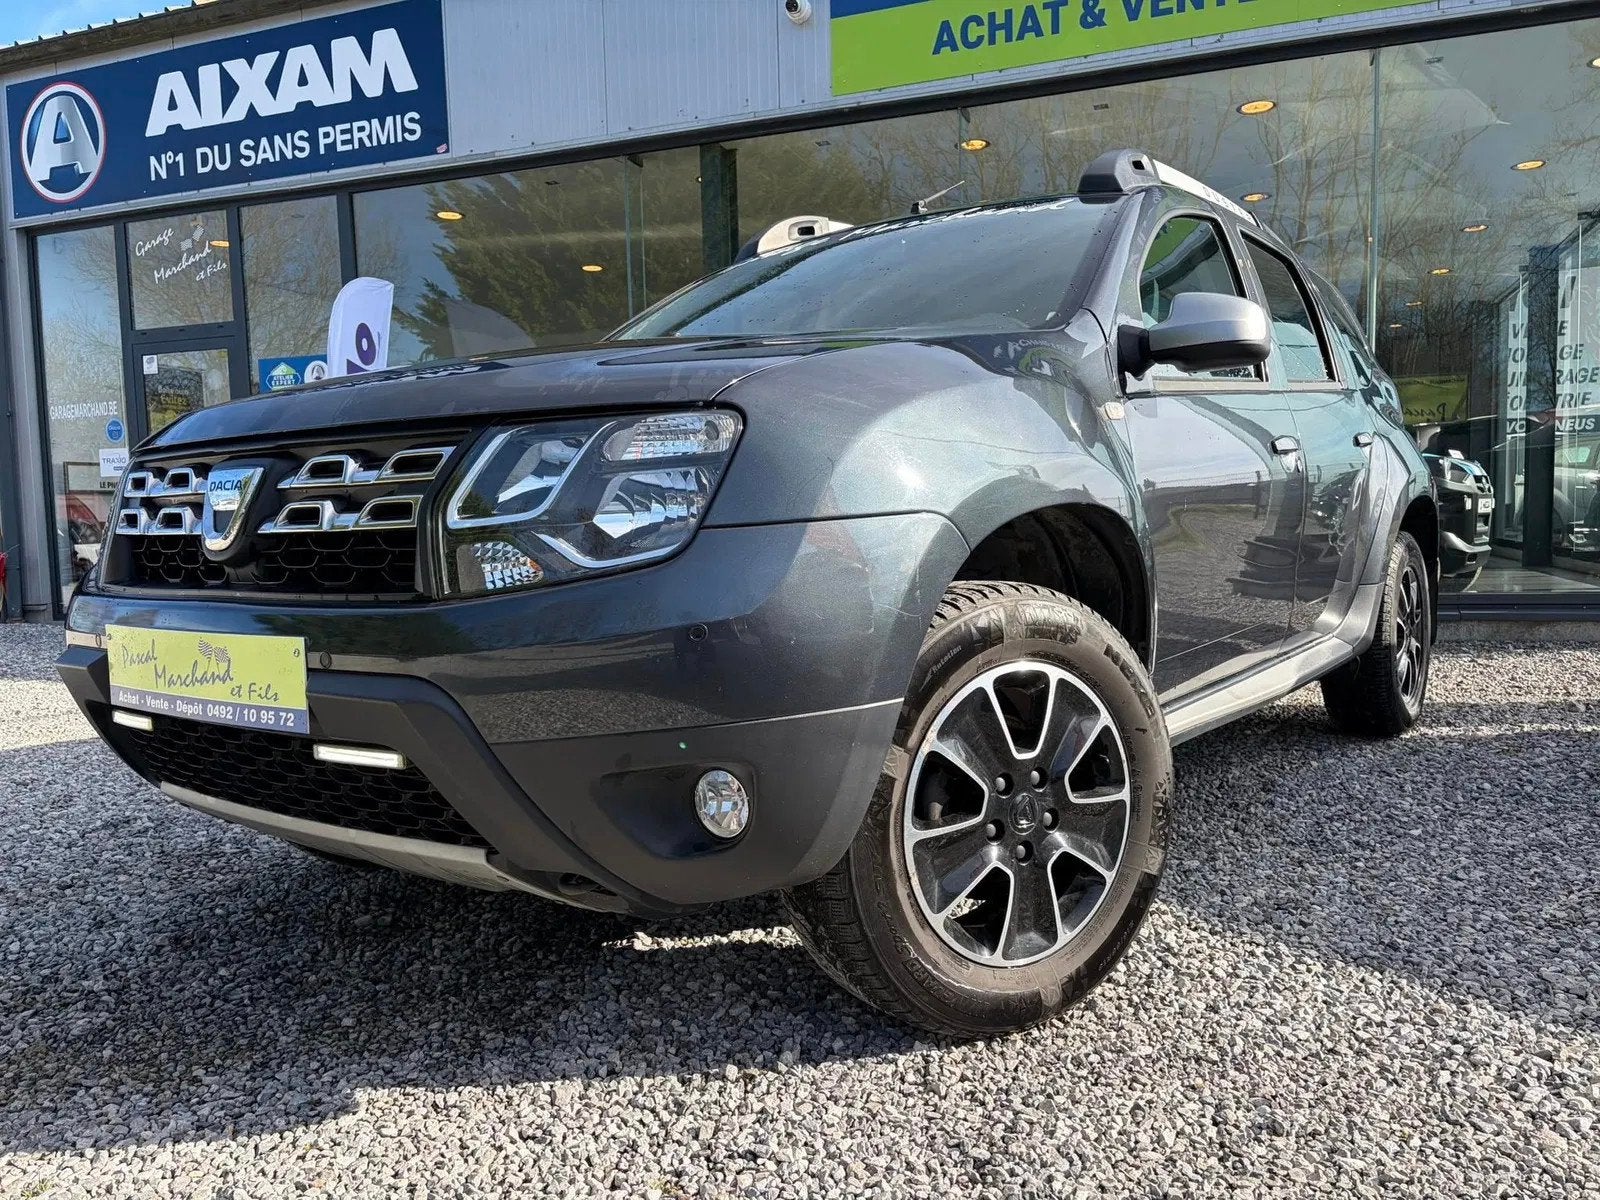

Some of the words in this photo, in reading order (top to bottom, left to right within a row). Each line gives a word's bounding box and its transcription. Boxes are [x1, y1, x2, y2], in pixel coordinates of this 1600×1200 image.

[932, 0, 1069, 55] ACHAT
[1079, 0, 1108, 30] &
[145, 27, 419, 138] AIXAM
[196, 142, 231, 173] DU
[239, 129, 311, 166] SANS
[319, 111, 422, 155] PERMIS
[135, 228, 174, 257] Garage
[153, 240, 212, 284] Marchand
[206, 260, 227, 277] Fils
[209, 479, 243, 492] DACIA
[121, 639, 158, 669] Pascal
[154, 657, 234, 689] Marchand
[230, 685, 243, 698] et
[248, 682, 280, 702] Fils
[118, 690, 139, 705] Achat
[145, 695, 169, 711] Vente
[176, 699, 203, 717] Dépôt
[207, 705, 233, 720] 0492
[243, 709, 257, 723] 10
[260, 710, 275, 725] 95
[279, 711, 295, 727] 72
